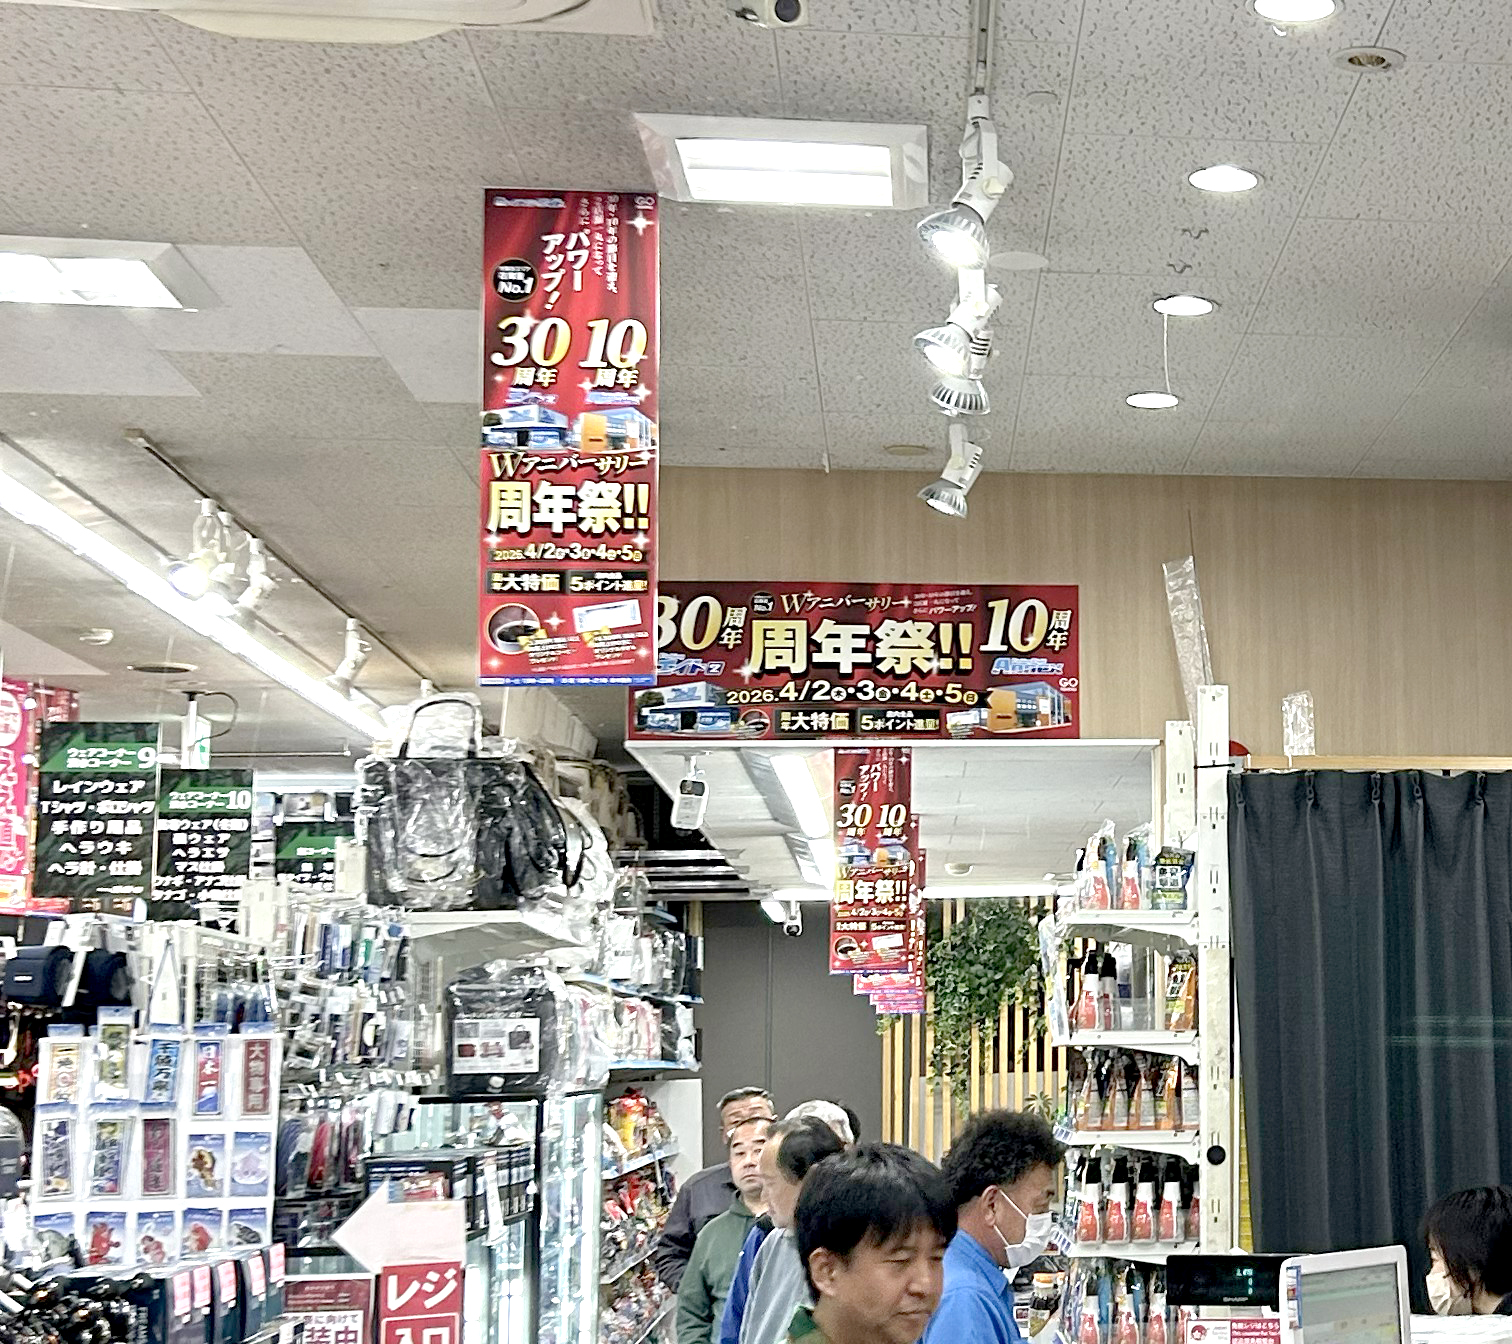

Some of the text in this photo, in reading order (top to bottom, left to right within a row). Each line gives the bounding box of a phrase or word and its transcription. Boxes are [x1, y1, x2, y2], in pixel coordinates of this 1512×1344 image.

[497, 276, 534, 295] No.1
[491, 316, 649, 369] 30 10
[512, 367, 640, 389] 周年 周年
[720, 605, 748, 650] 周年
[979, 597, 1048, 653] 10
[1047, 609, 1073, 652] 周年
[137, 747, 156, 769] 9
[52, 779, 146, 795] レインウェア
[226, 790, 252, 810] 10
[836, 803, 907, 829] 30 10
[386, 1267, 458, 1311] レジ
